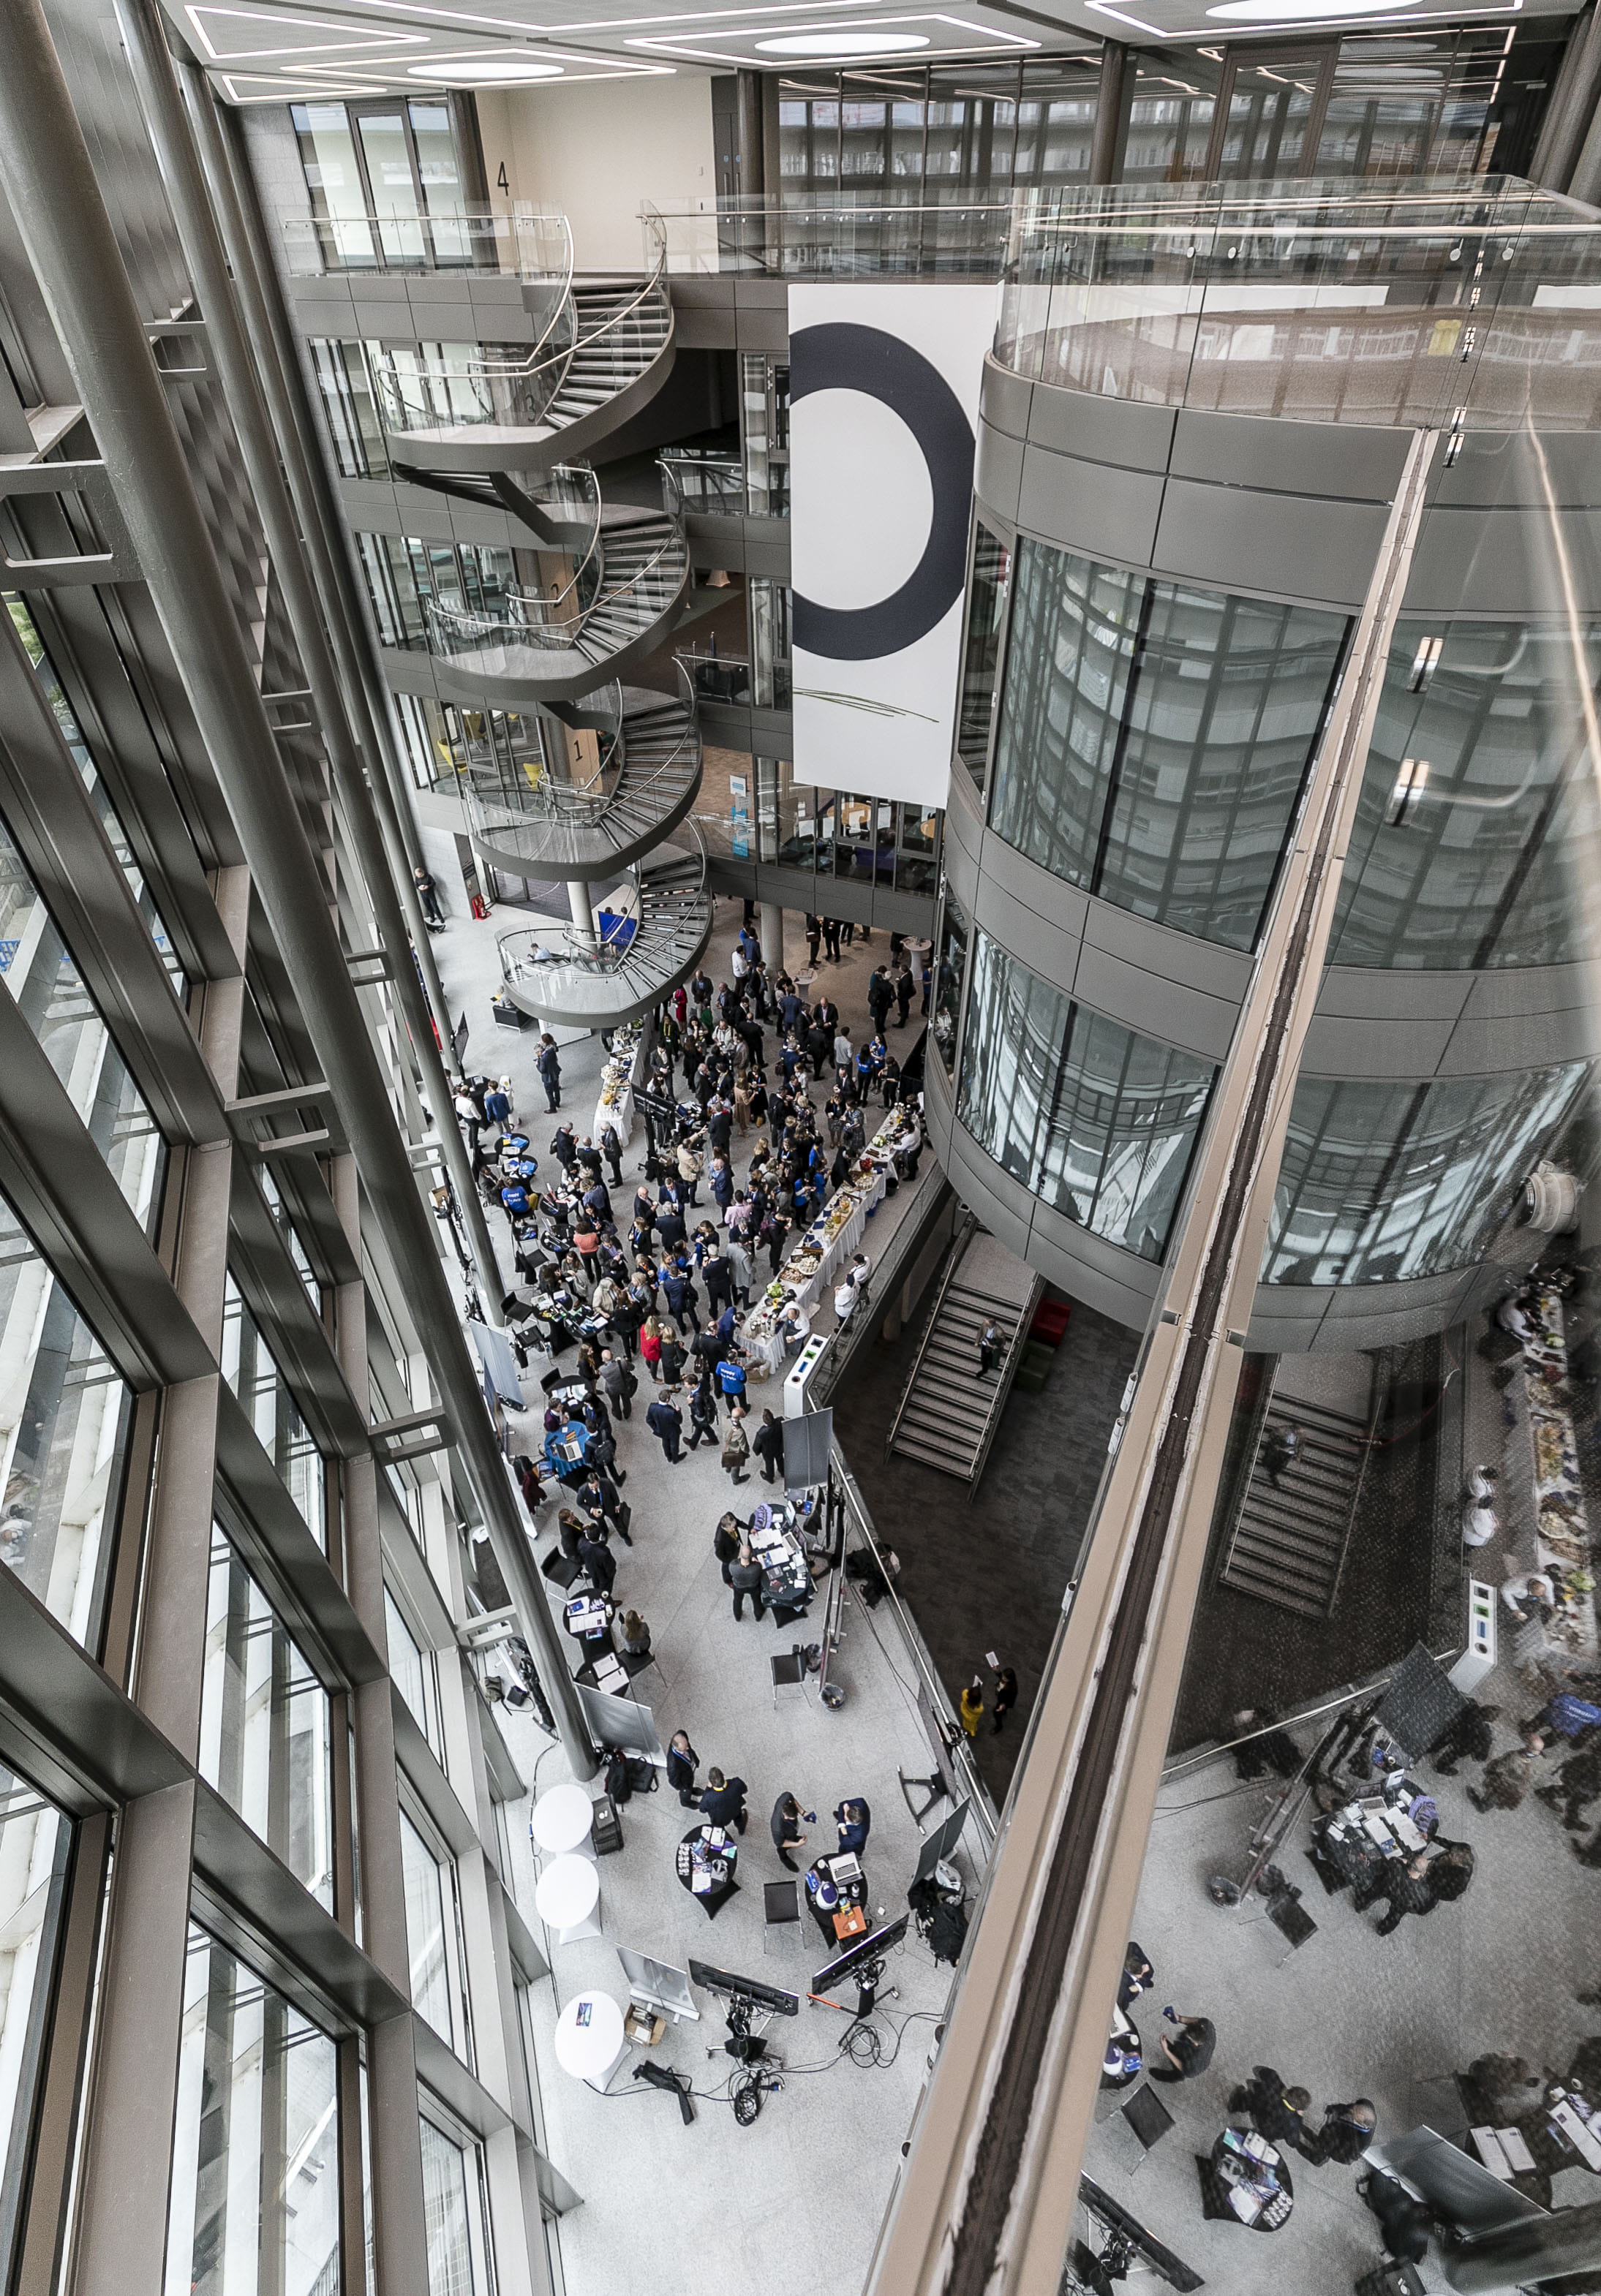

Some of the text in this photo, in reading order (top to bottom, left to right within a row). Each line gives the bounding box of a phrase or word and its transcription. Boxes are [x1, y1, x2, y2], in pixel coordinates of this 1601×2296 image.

[497, 161, 509, 197] 4
[526, 394, 536, 423] 3
[573, 739, 583, 762] 1
